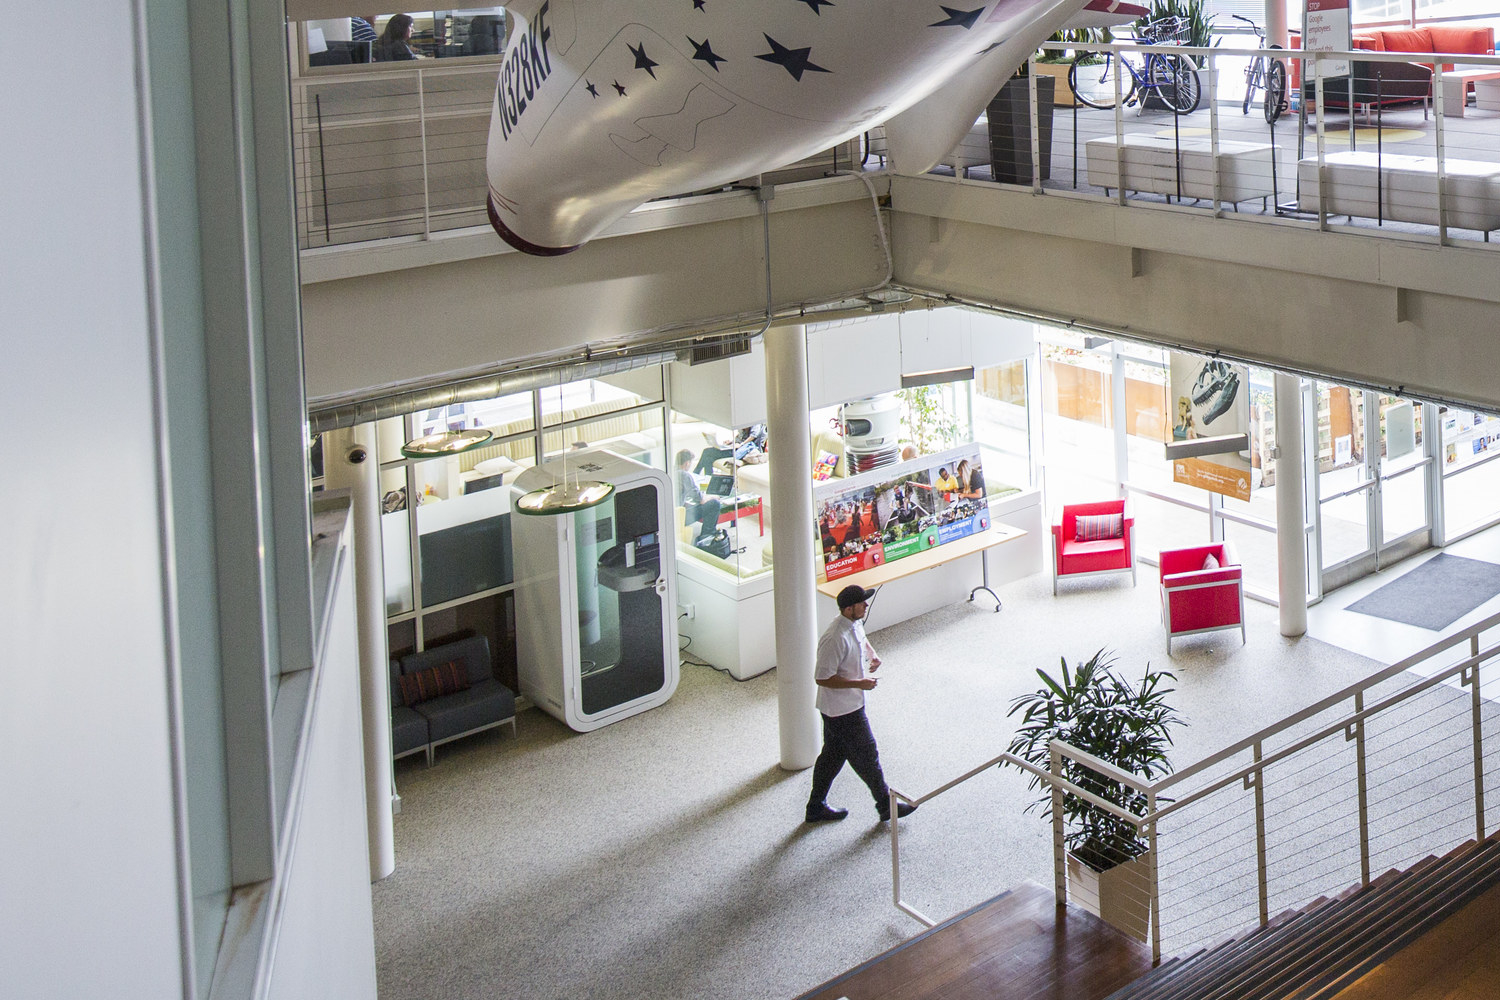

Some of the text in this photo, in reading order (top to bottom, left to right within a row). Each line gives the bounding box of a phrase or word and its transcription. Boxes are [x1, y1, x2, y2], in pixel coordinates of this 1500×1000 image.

[1308, 2, 1321, 11] STOP
[1308, 14, 1323, 24] Google
[1308, 25, 1332, 34] employees
[1308, 37, 1318, 45] only
[938, 519, 972, 535] EMPLOYMENT
[884, 536, 920, 552] ENVIRONMENT
[826, 556, 858, 571] EDUCATION
